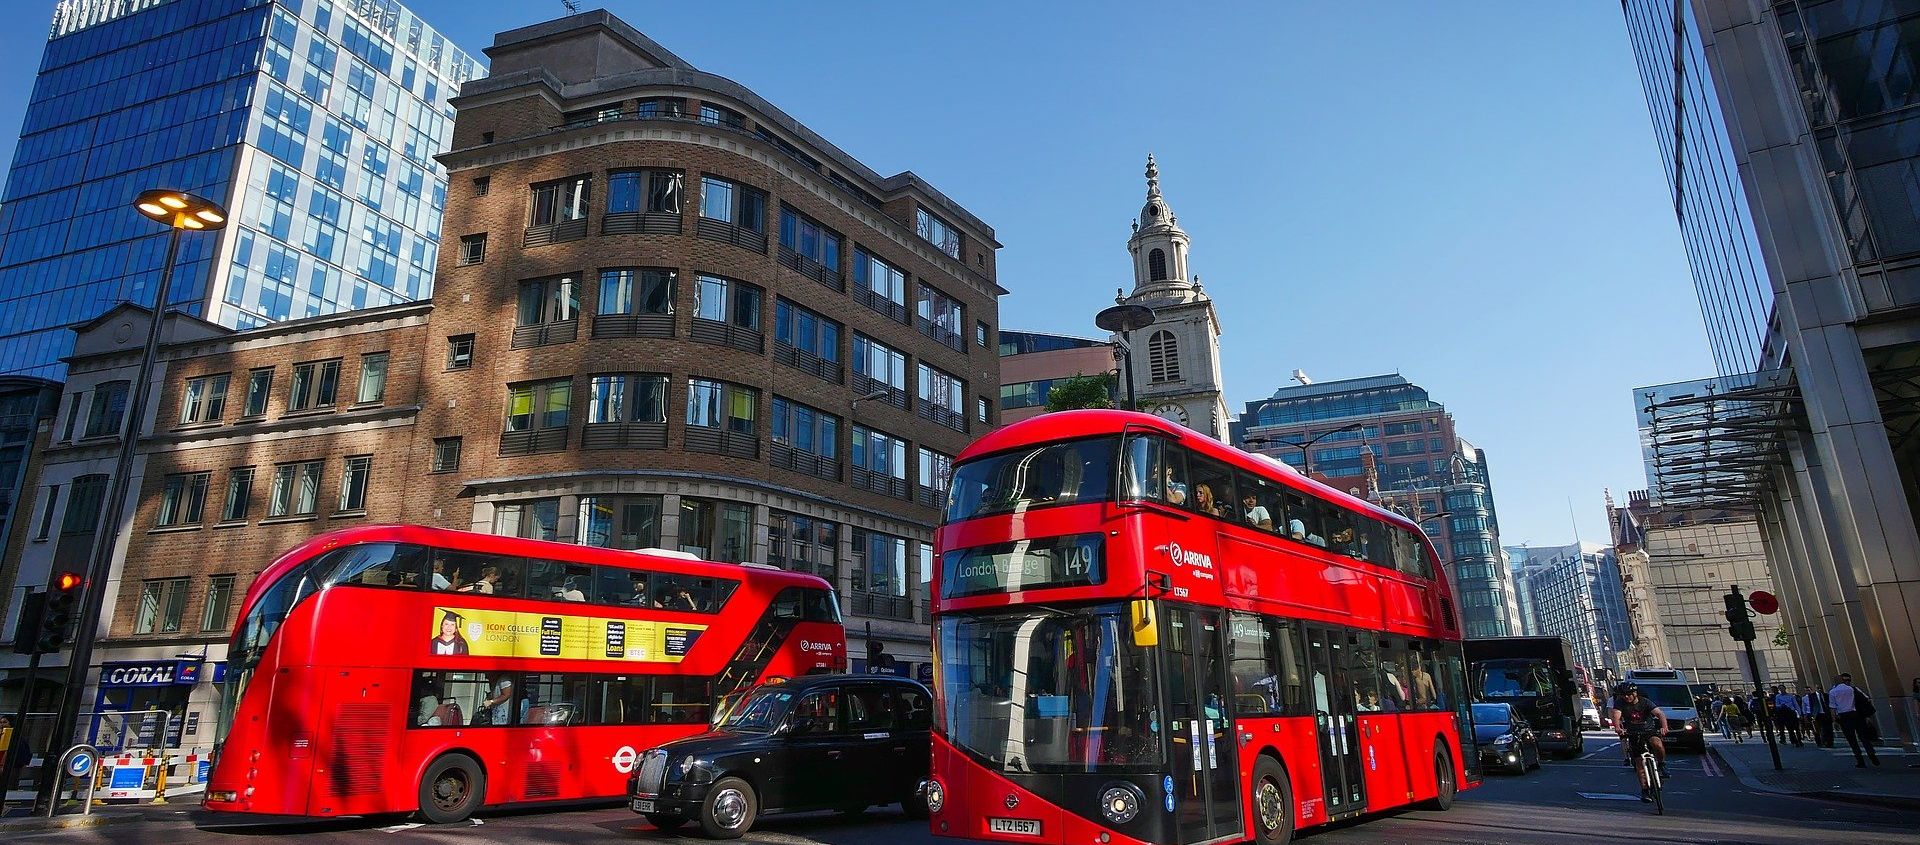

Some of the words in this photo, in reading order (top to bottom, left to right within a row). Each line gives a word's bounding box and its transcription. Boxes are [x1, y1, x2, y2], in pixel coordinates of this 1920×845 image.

[959, 561, 998, 578] London
[1065, 544, 1092, 576] 149
[1184, 550, 1213, 569] ARRIVA
[1173, 586, 1188, 598] LT567
[486, 623, 506, 632] ICON
[507, 624, 539, 633] COLLEGE
[1232, 623, 1243, 638] 149
[1244, 626, 1259, 637] London
[486, 634, 520, 643] LONDON
[606, 644, 624, 652] Loans
[810, 643, 832, 651] ARRIVA
[110, 666, 174, 684] CORAL
[995, 819, 1013, 831] LTZ
[1014, 820, 1034, 832] 1567
